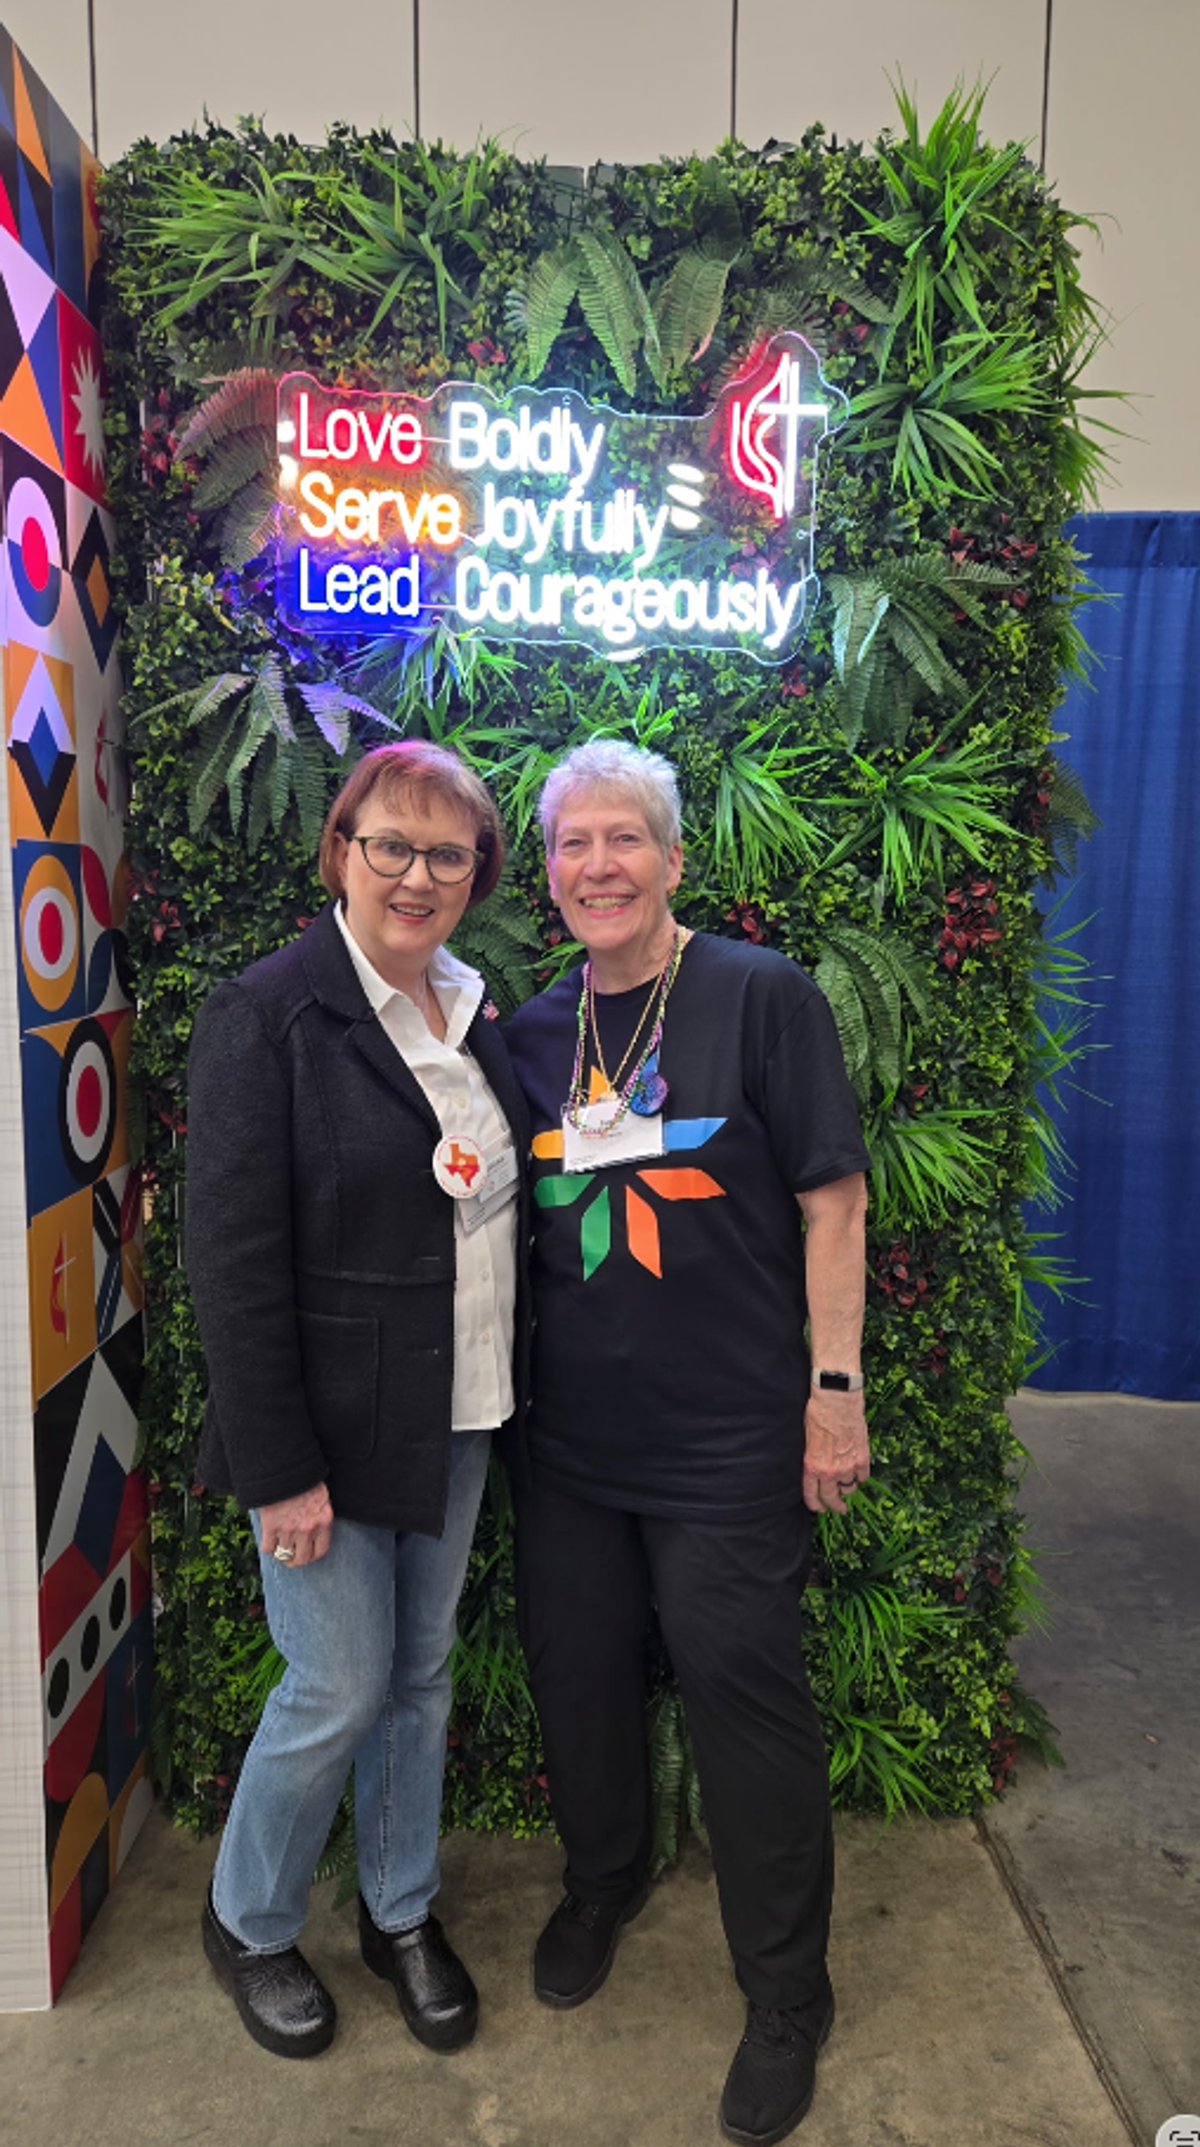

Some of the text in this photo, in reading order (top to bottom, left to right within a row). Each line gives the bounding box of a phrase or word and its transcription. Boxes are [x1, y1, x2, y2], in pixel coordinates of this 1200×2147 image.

[299, 392, 603, 491] Love Boldly
[299, 471, 669, 567] Serve Joyfully
[299, 548, 801, 649] Lead Courageously
